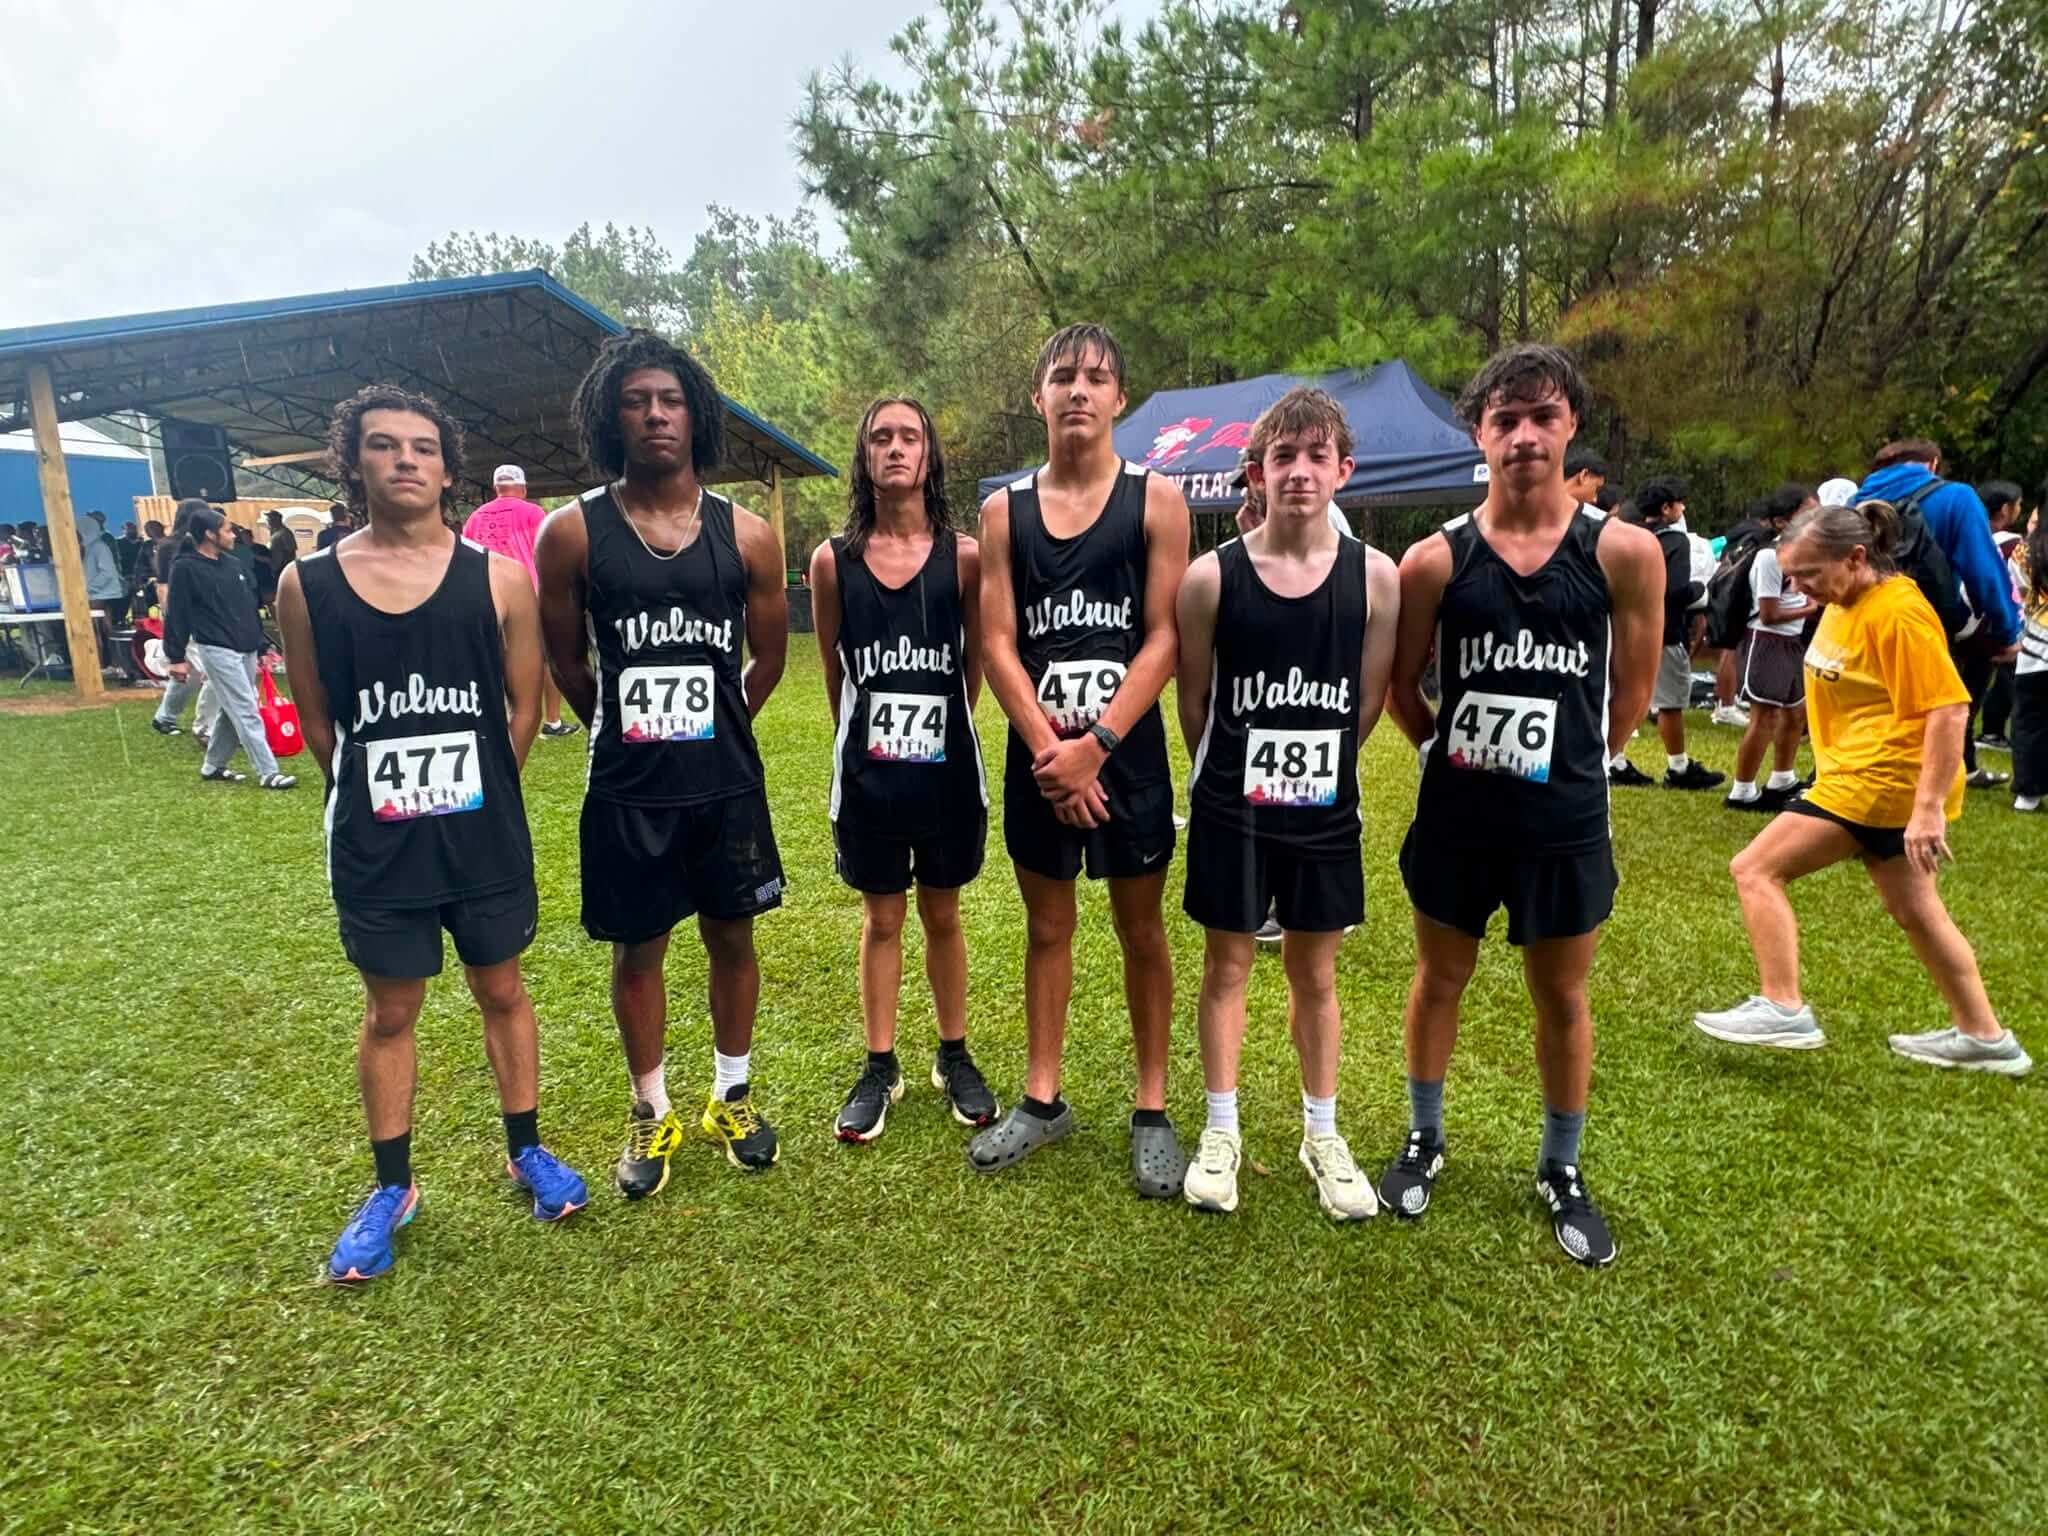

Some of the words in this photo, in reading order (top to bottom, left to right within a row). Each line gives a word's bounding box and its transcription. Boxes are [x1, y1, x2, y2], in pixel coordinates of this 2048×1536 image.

[614, 606, 733, 656] Walnut
[1025, 589, 1133, 640] Walnut
[854, 635, 954, 685] Walnut
[1459, 628, 1589, 679] Walnut
[352, 673, 482, 734] Walnut
[624, 677, 709, 714] 478
[1041, 668, 1121, 709] 479
[1232, 666, 1351, 717] Walnut
[872, 703, 943, 738] 474
[1454, 703, 1548, 751] 476
[374, 743, 470, 790] 477
[1250, 741, 1333, 778] 481
